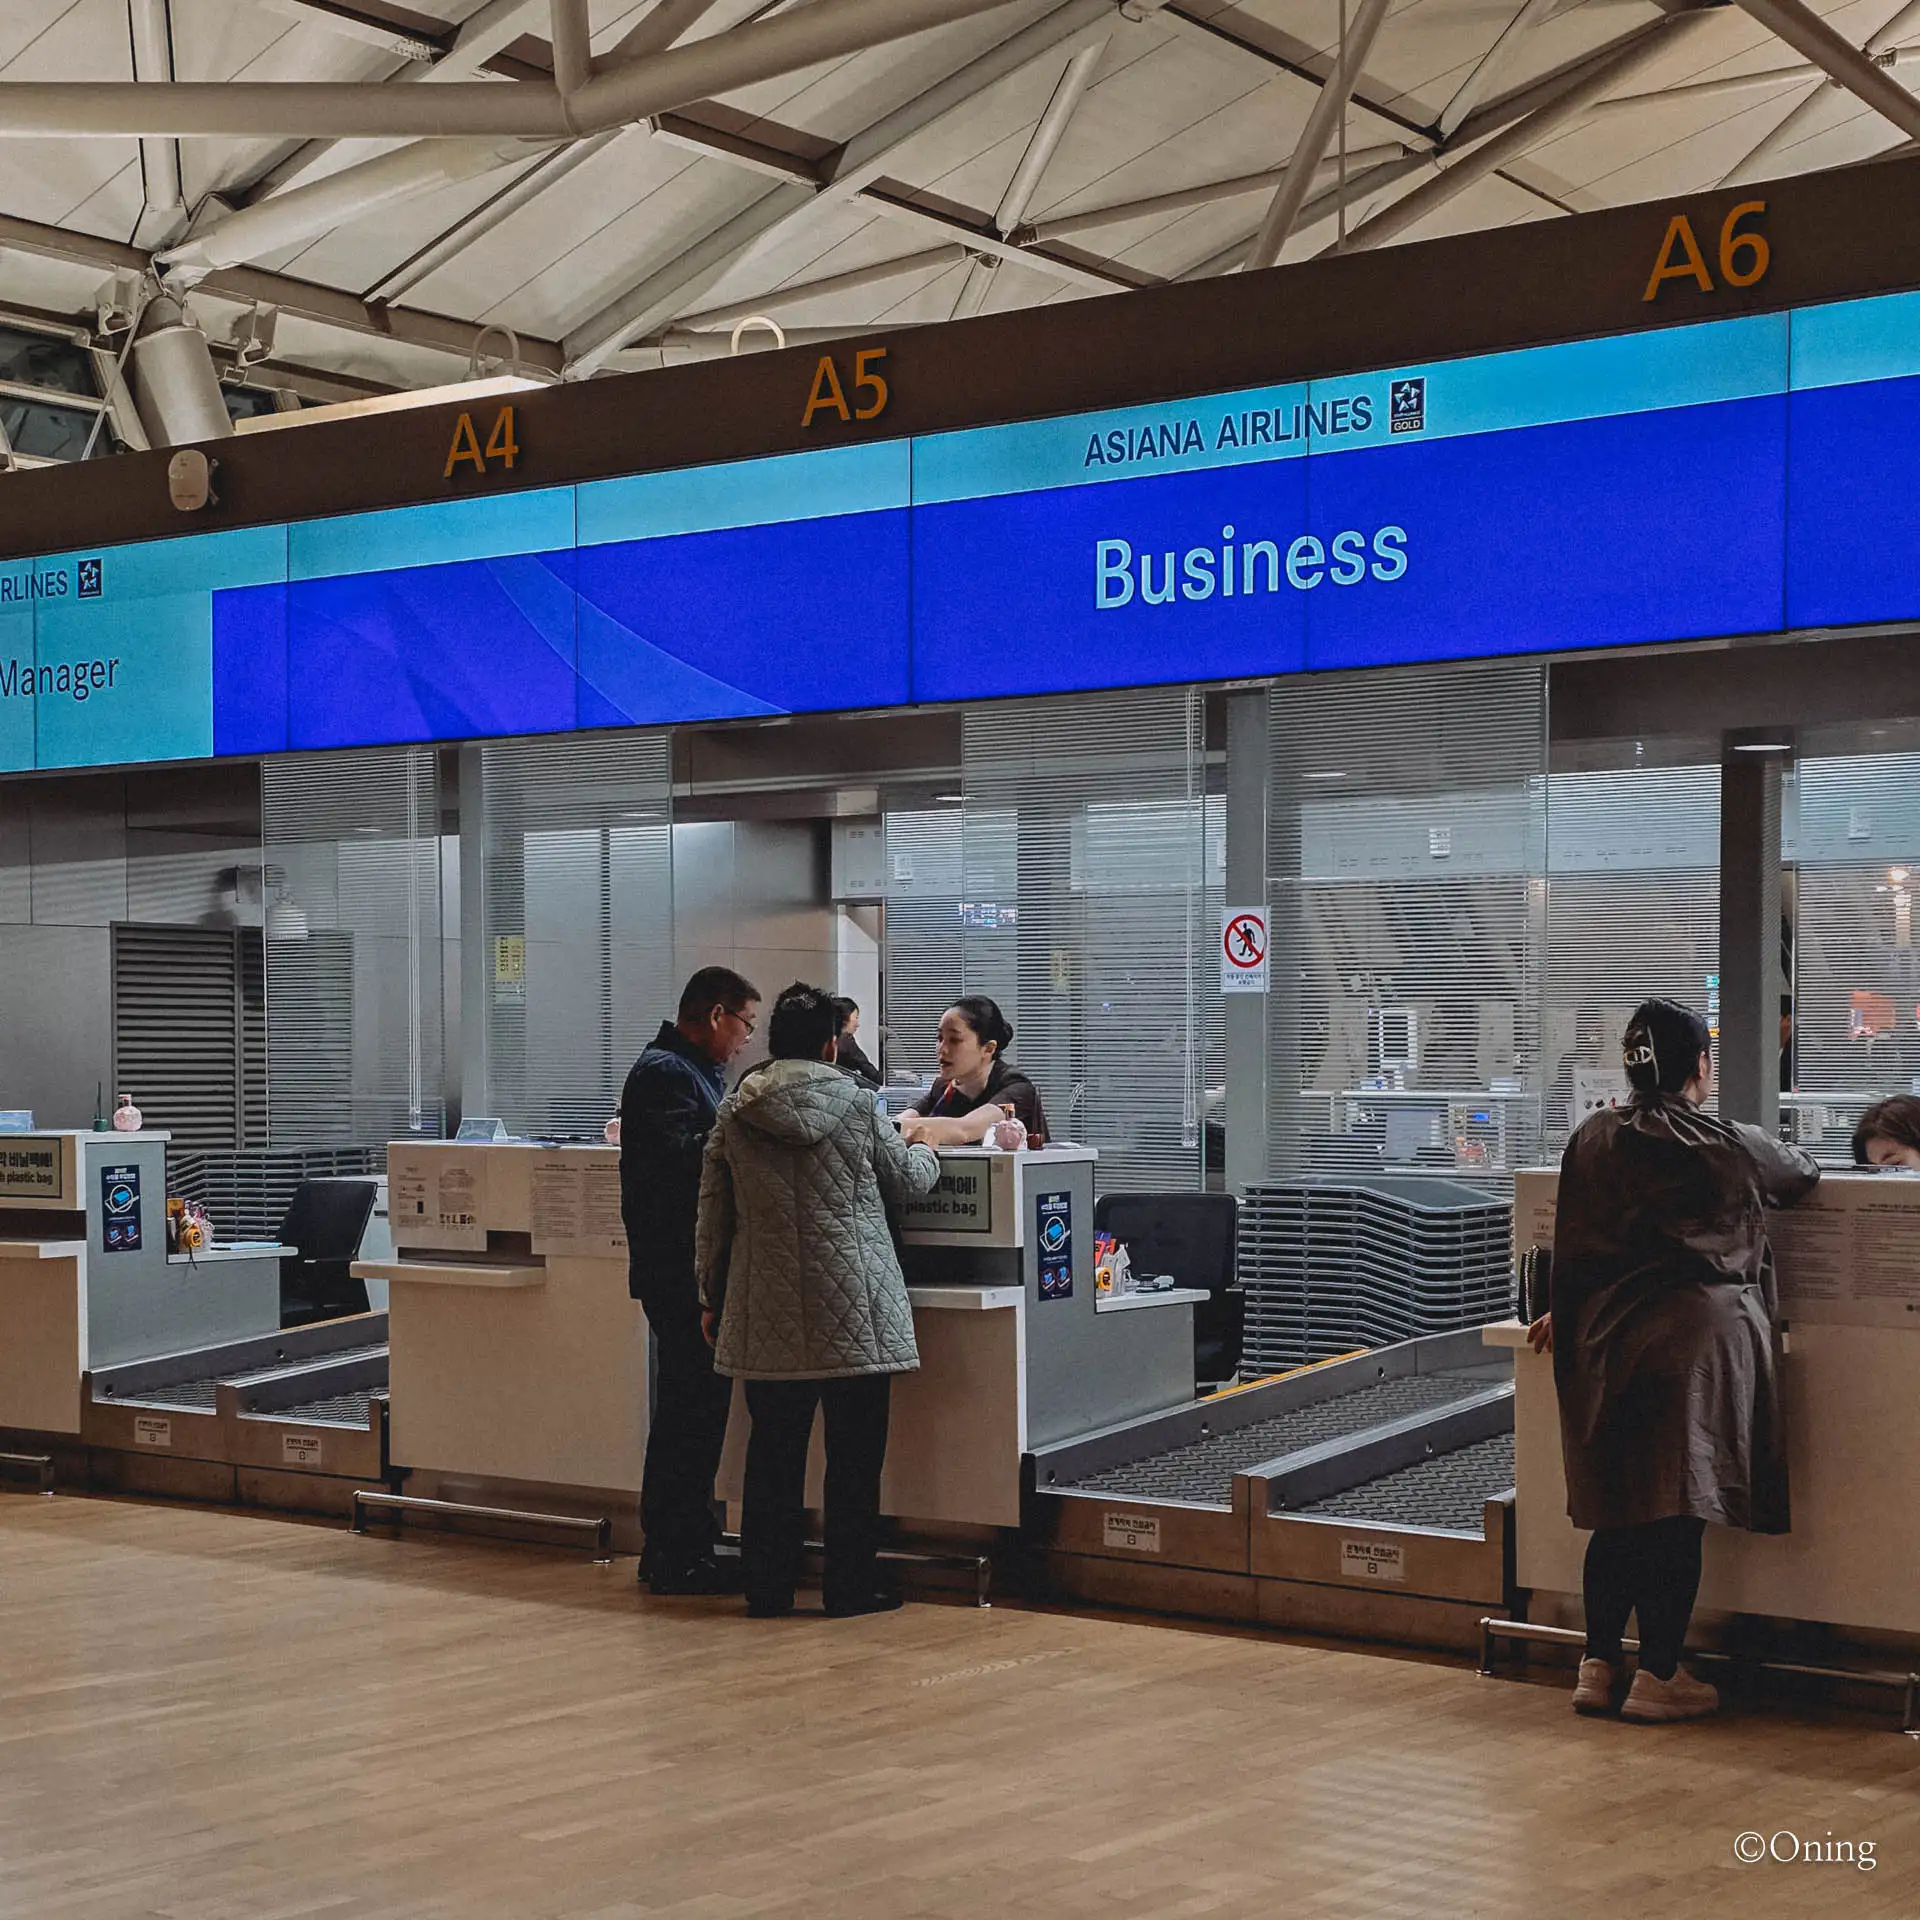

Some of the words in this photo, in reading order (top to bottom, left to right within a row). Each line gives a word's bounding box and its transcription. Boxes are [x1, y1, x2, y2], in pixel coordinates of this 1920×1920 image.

[1642, 201, 1770, 301] A6
[801, 347, 888, 427] A5
[444, 406, 519, 479] A4
[1084, 420, 1205, 467] ASIANA
[1216, 395, 1373, 449] AIRLINES
[1394, 420, 1421, 431] GOLD
[0, 570, 68, 601] RLINES
[1096, 524, 1408, 610] Business
[0, 658, 120, 702] Manager
[7, 1171, 35, 1185] plastic
[37, 1171, 53, 1186] bag
[905, 1200, 949, 1216] plastic
[952, 1200, 977, 1216] bag
